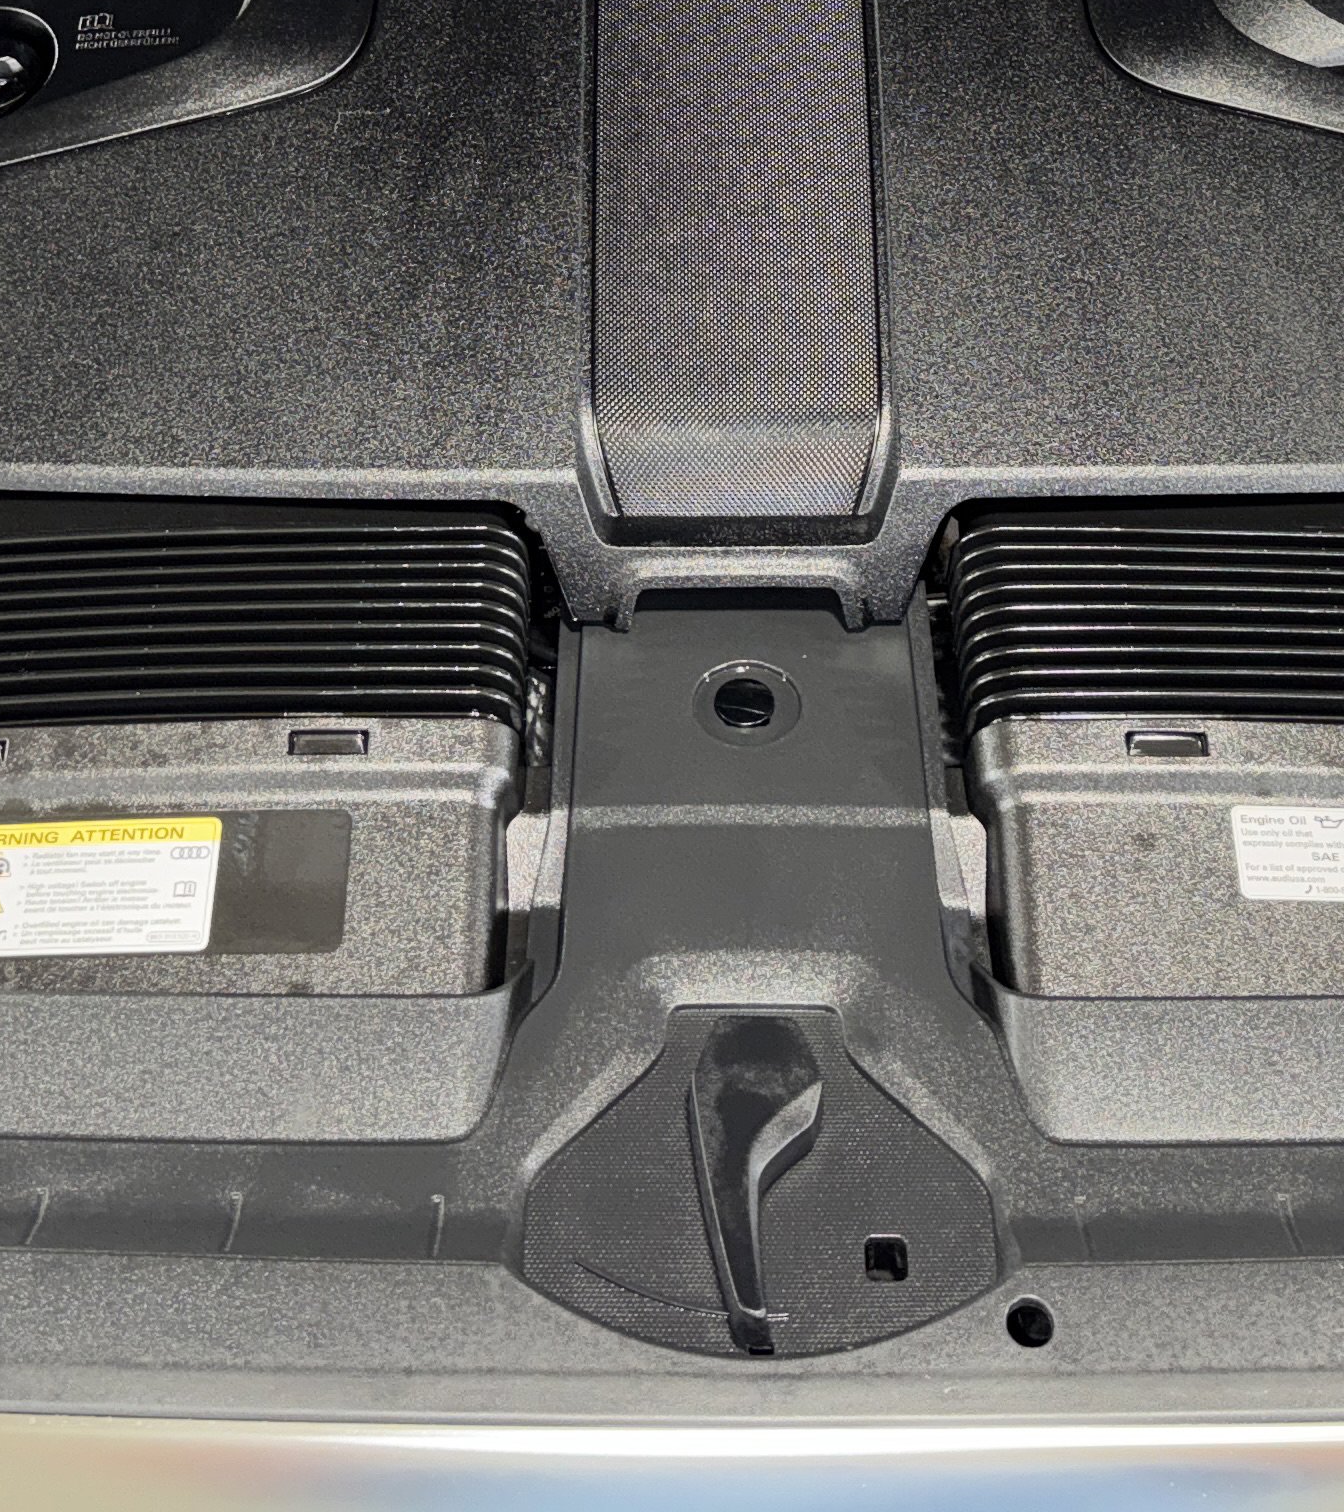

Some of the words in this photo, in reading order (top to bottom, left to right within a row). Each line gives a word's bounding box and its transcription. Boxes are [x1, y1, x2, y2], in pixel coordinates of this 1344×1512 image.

[1240, 815, 1284, 825] Engine
[1290, 816, 1306, 824] Oil
[70, 826, 185, 844] ATTENTION
[1312, 852, 1340, 861] SAE
[1246, 863, 1260, 871] For
